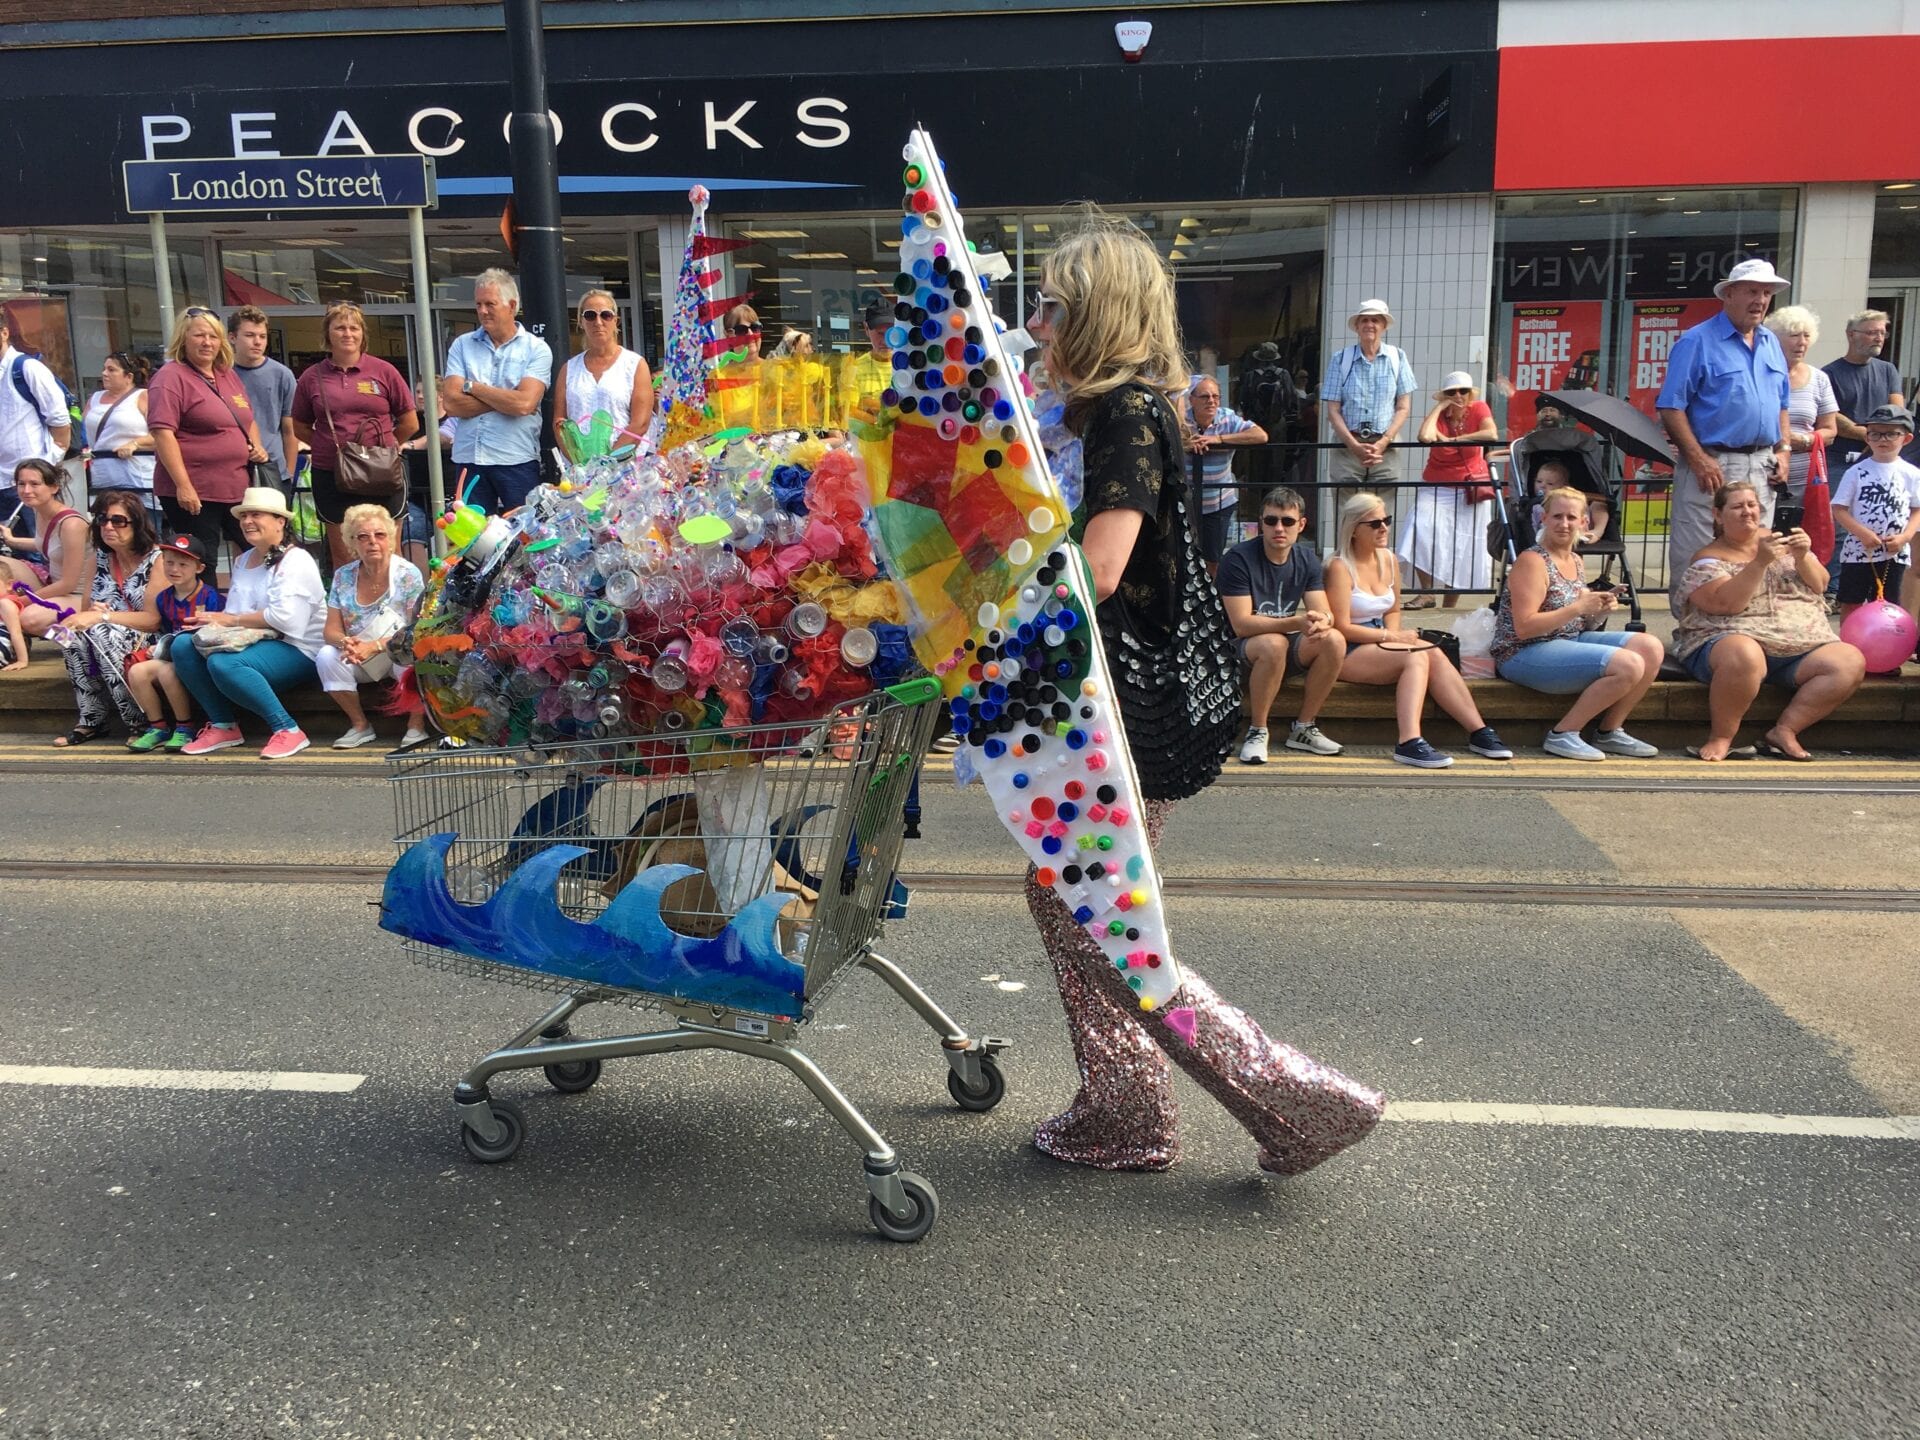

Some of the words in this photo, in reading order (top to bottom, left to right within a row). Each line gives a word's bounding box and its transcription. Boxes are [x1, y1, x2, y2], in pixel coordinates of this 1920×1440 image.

[1120, 29, 1147, 37] KINGS
[168, 171, 288, 201] London
[296, 169, 383, 199] Street
[532, 323, 546, 334] CF
[1518, 332, 1572, 362] FREE
[1638, 330, 1687, 361] FRE
[1636, 362, 1669, 390] BE
[1858, 482, 1905, 514] BATMAN
